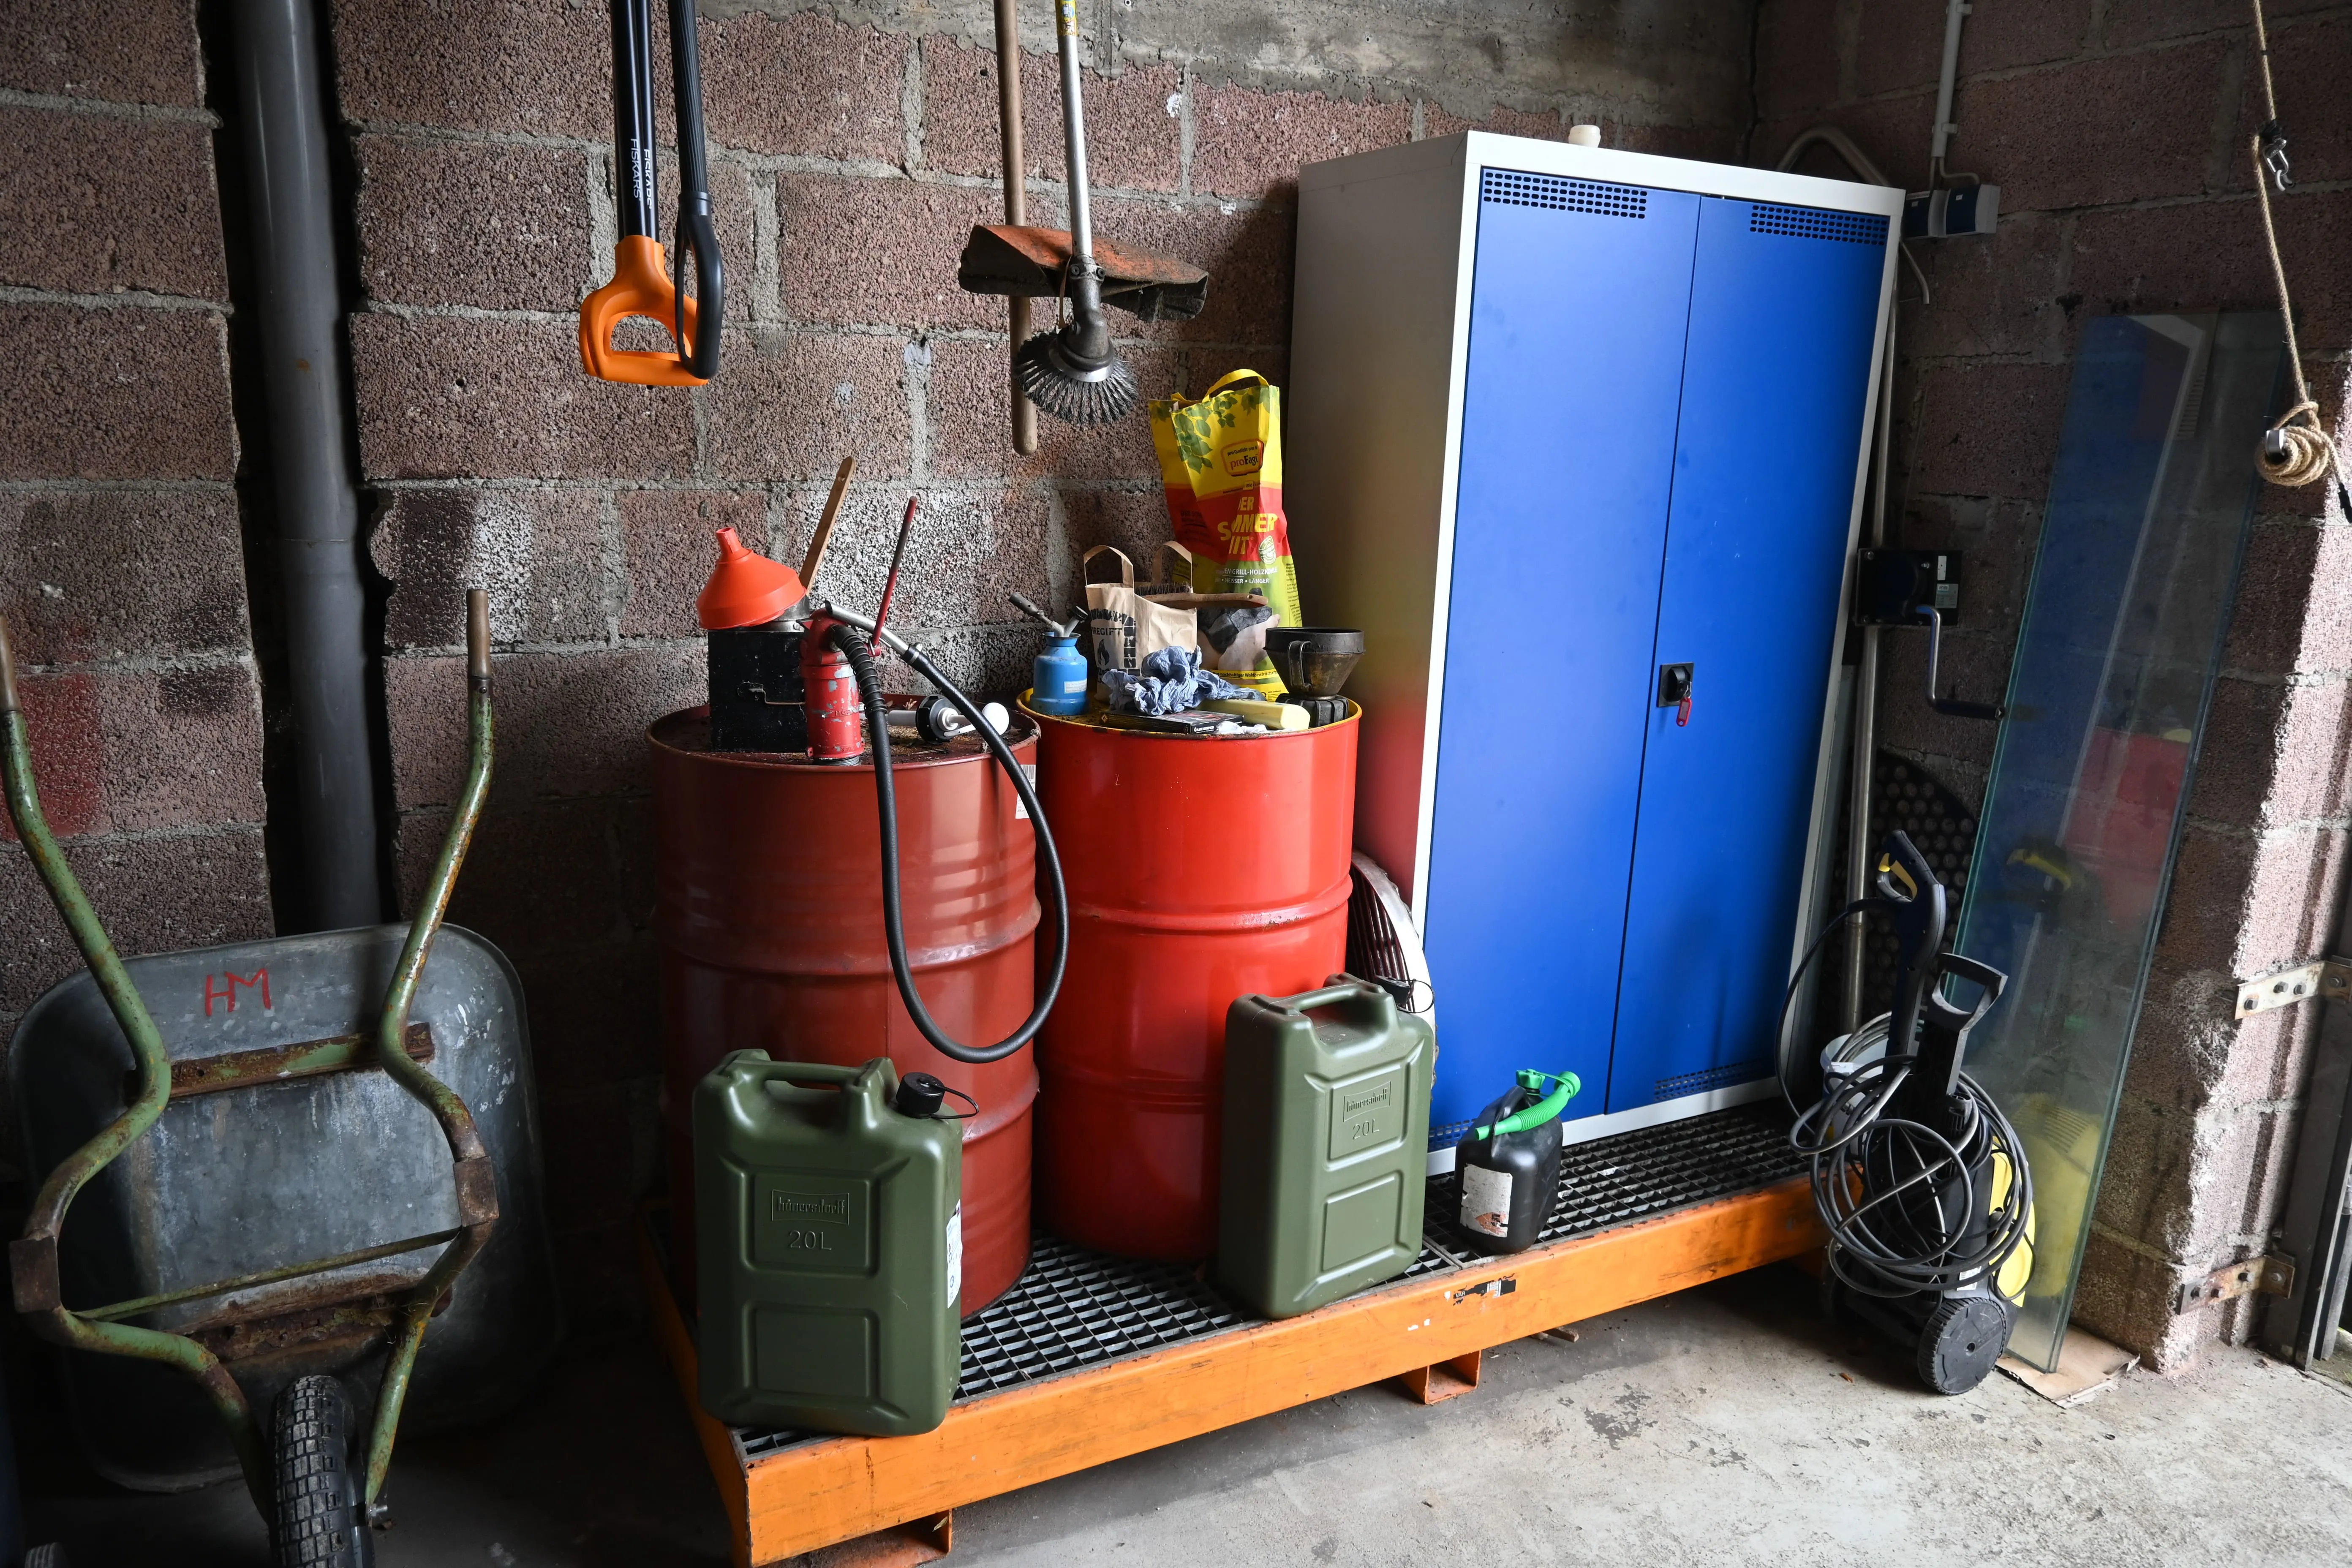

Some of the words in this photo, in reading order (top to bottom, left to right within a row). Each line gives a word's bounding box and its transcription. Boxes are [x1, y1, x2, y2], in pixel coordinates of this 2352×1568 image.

[631, 138, 642, 199] FISKARS
[1217, 513, 1278, 540] SMMER
[1092, 626, 1122, 637] IREGIFT
[205, 968, 271, 1017] HM
[1352, 1118, 1380, 1140] 20L
[789, 1230, 832, 1250] 20L
